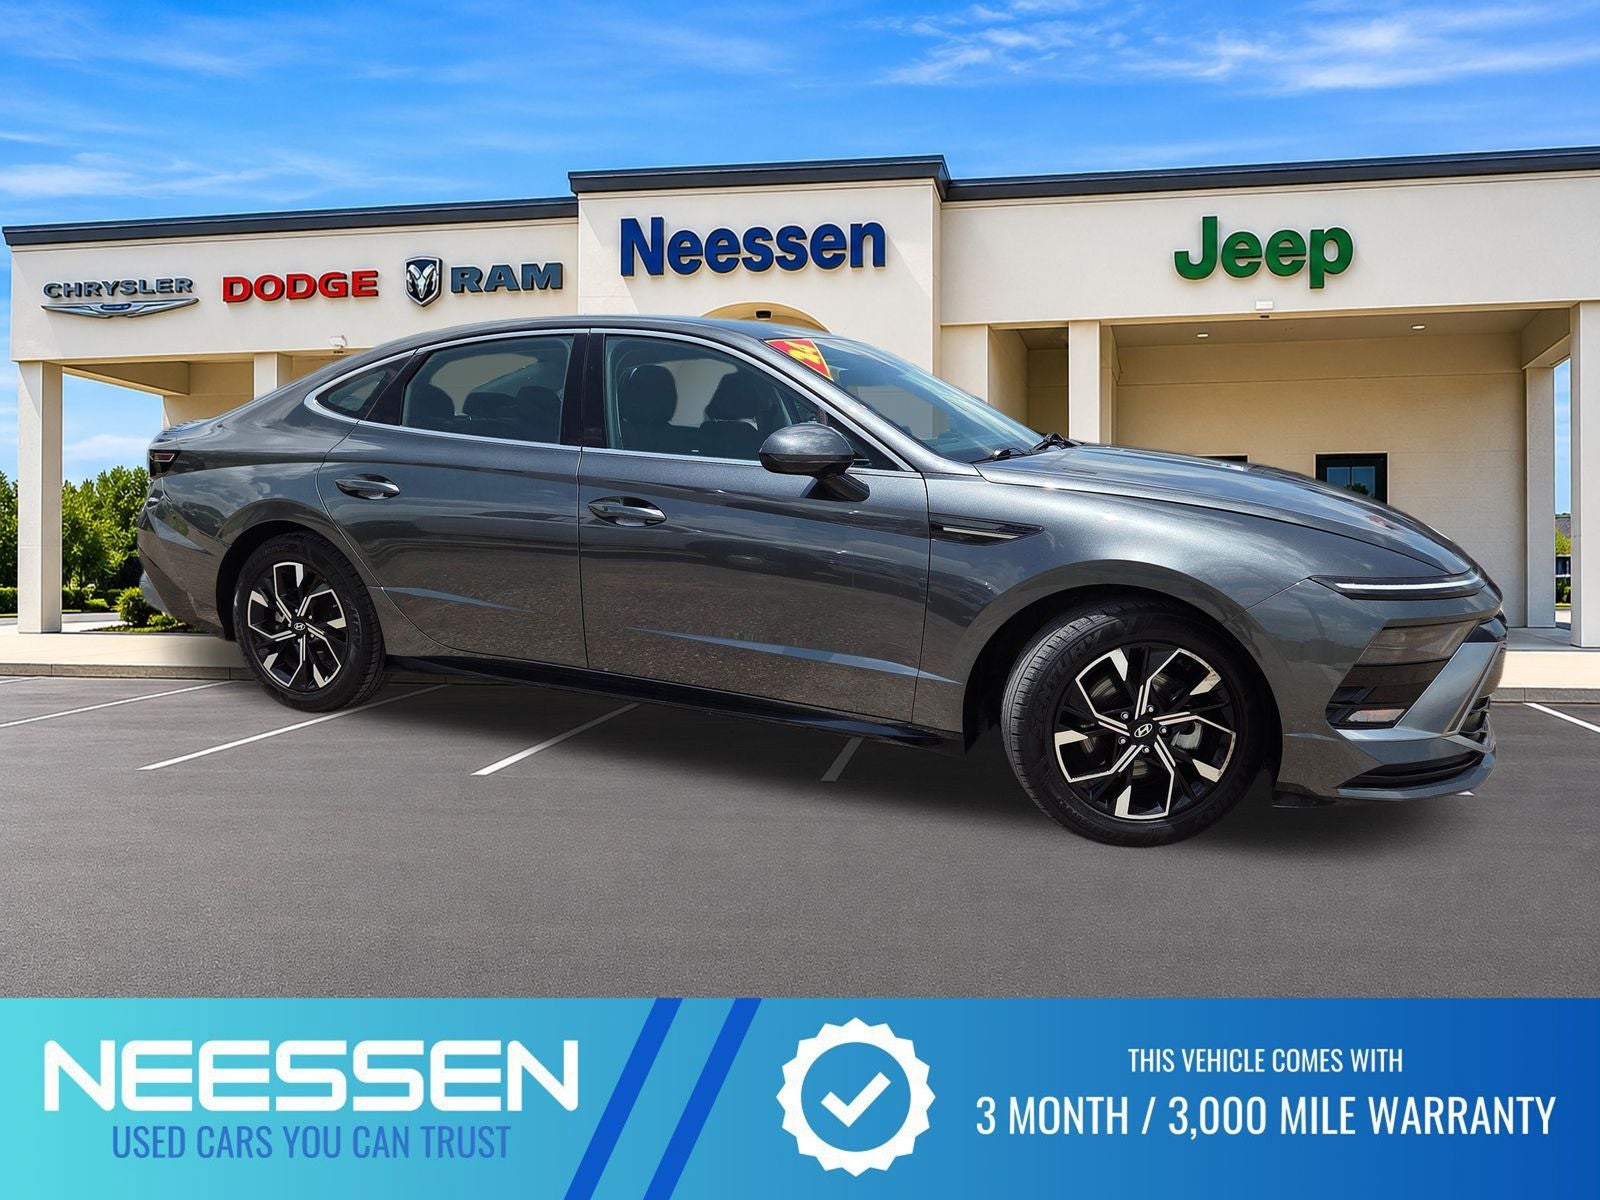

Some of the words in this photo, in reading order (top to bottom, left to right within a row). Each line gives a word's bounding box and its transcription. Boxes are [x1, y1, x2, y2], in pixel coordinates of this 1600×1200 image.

[620, 216, 886, 277] Neessen
[1174, 216, 1354, 289] Jeep
[43, 277, 194, 299] CHRYSLER
[222, 270, 379, 303] DODGE
[450, 262, 564, 294] RAM
